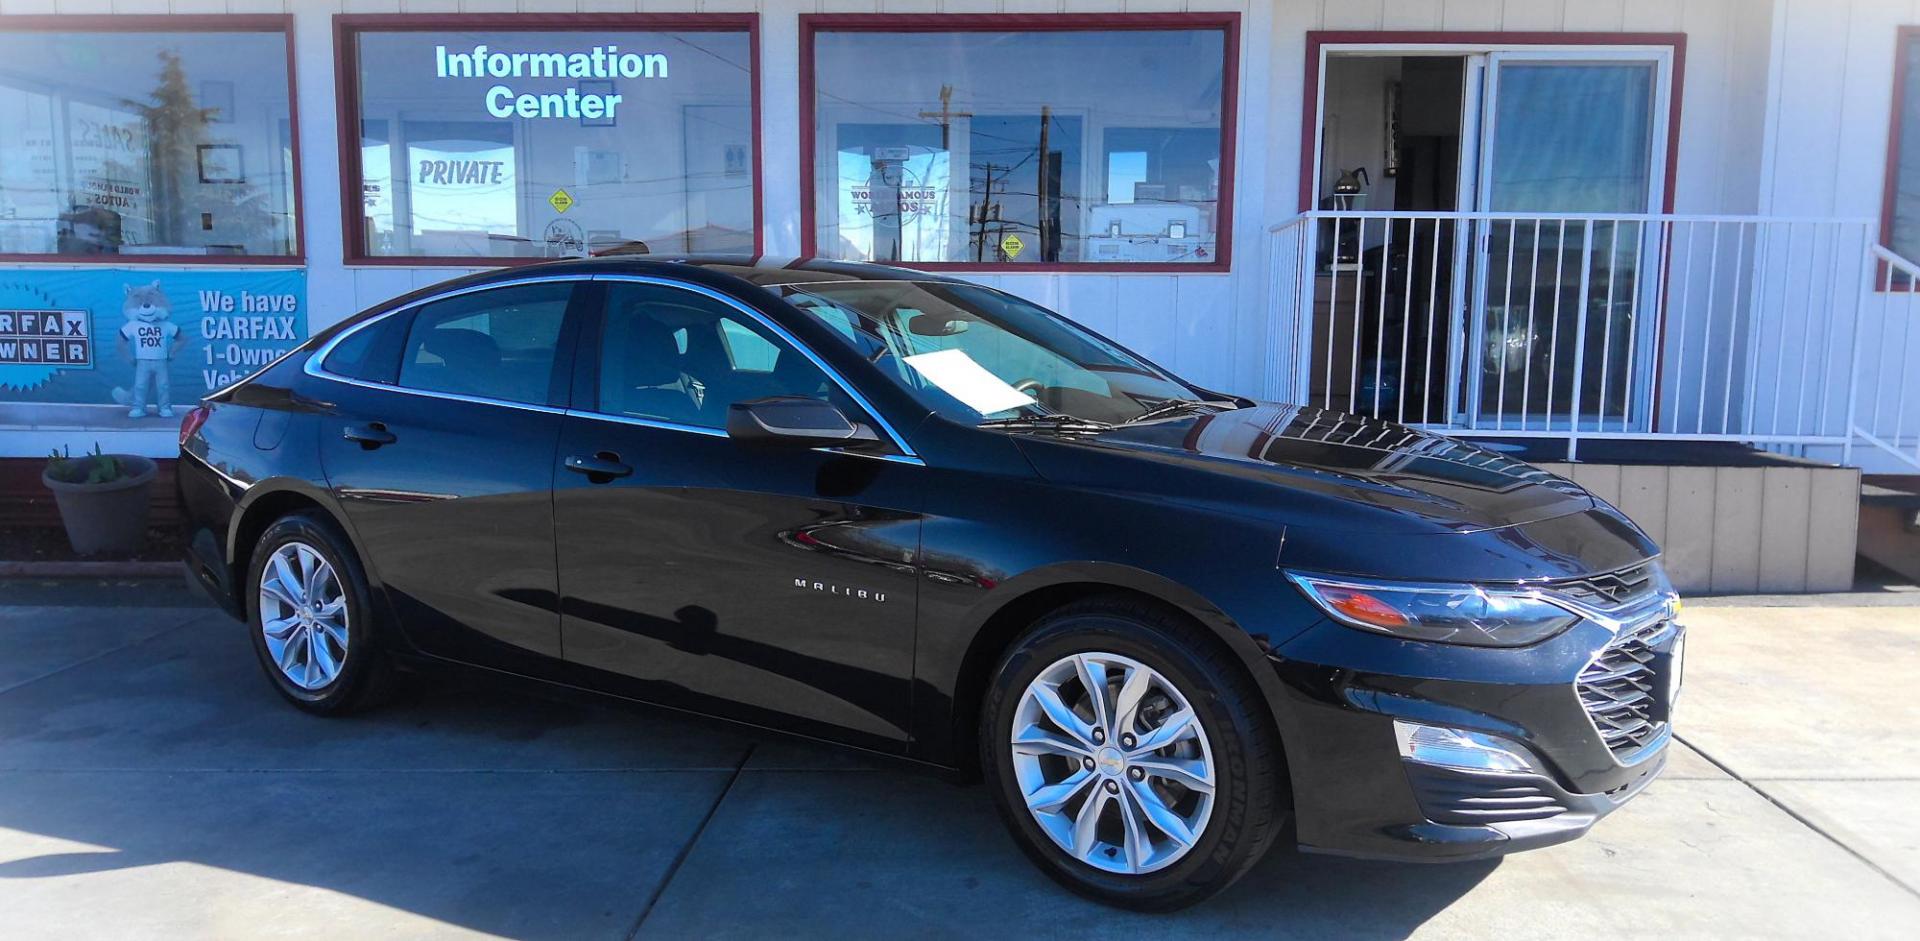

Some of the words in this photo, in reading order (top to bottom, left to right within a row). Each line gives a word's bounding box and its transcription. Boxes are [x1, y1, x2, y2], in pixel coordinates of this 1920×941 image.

[436, 45, 669, 78] Information
[486, 85, 622, 119] Center
[419, 159, 504, 184] PRIVATE
[199, 290, 235, 313] We
[241, 290, 297, 313] have
[138, 326, 162, 337] CAR
[201, 316, 297, 340] CARFAX
[140, 337, 162, 348] FOX
[794, 578, 885, 602] MALIBU
